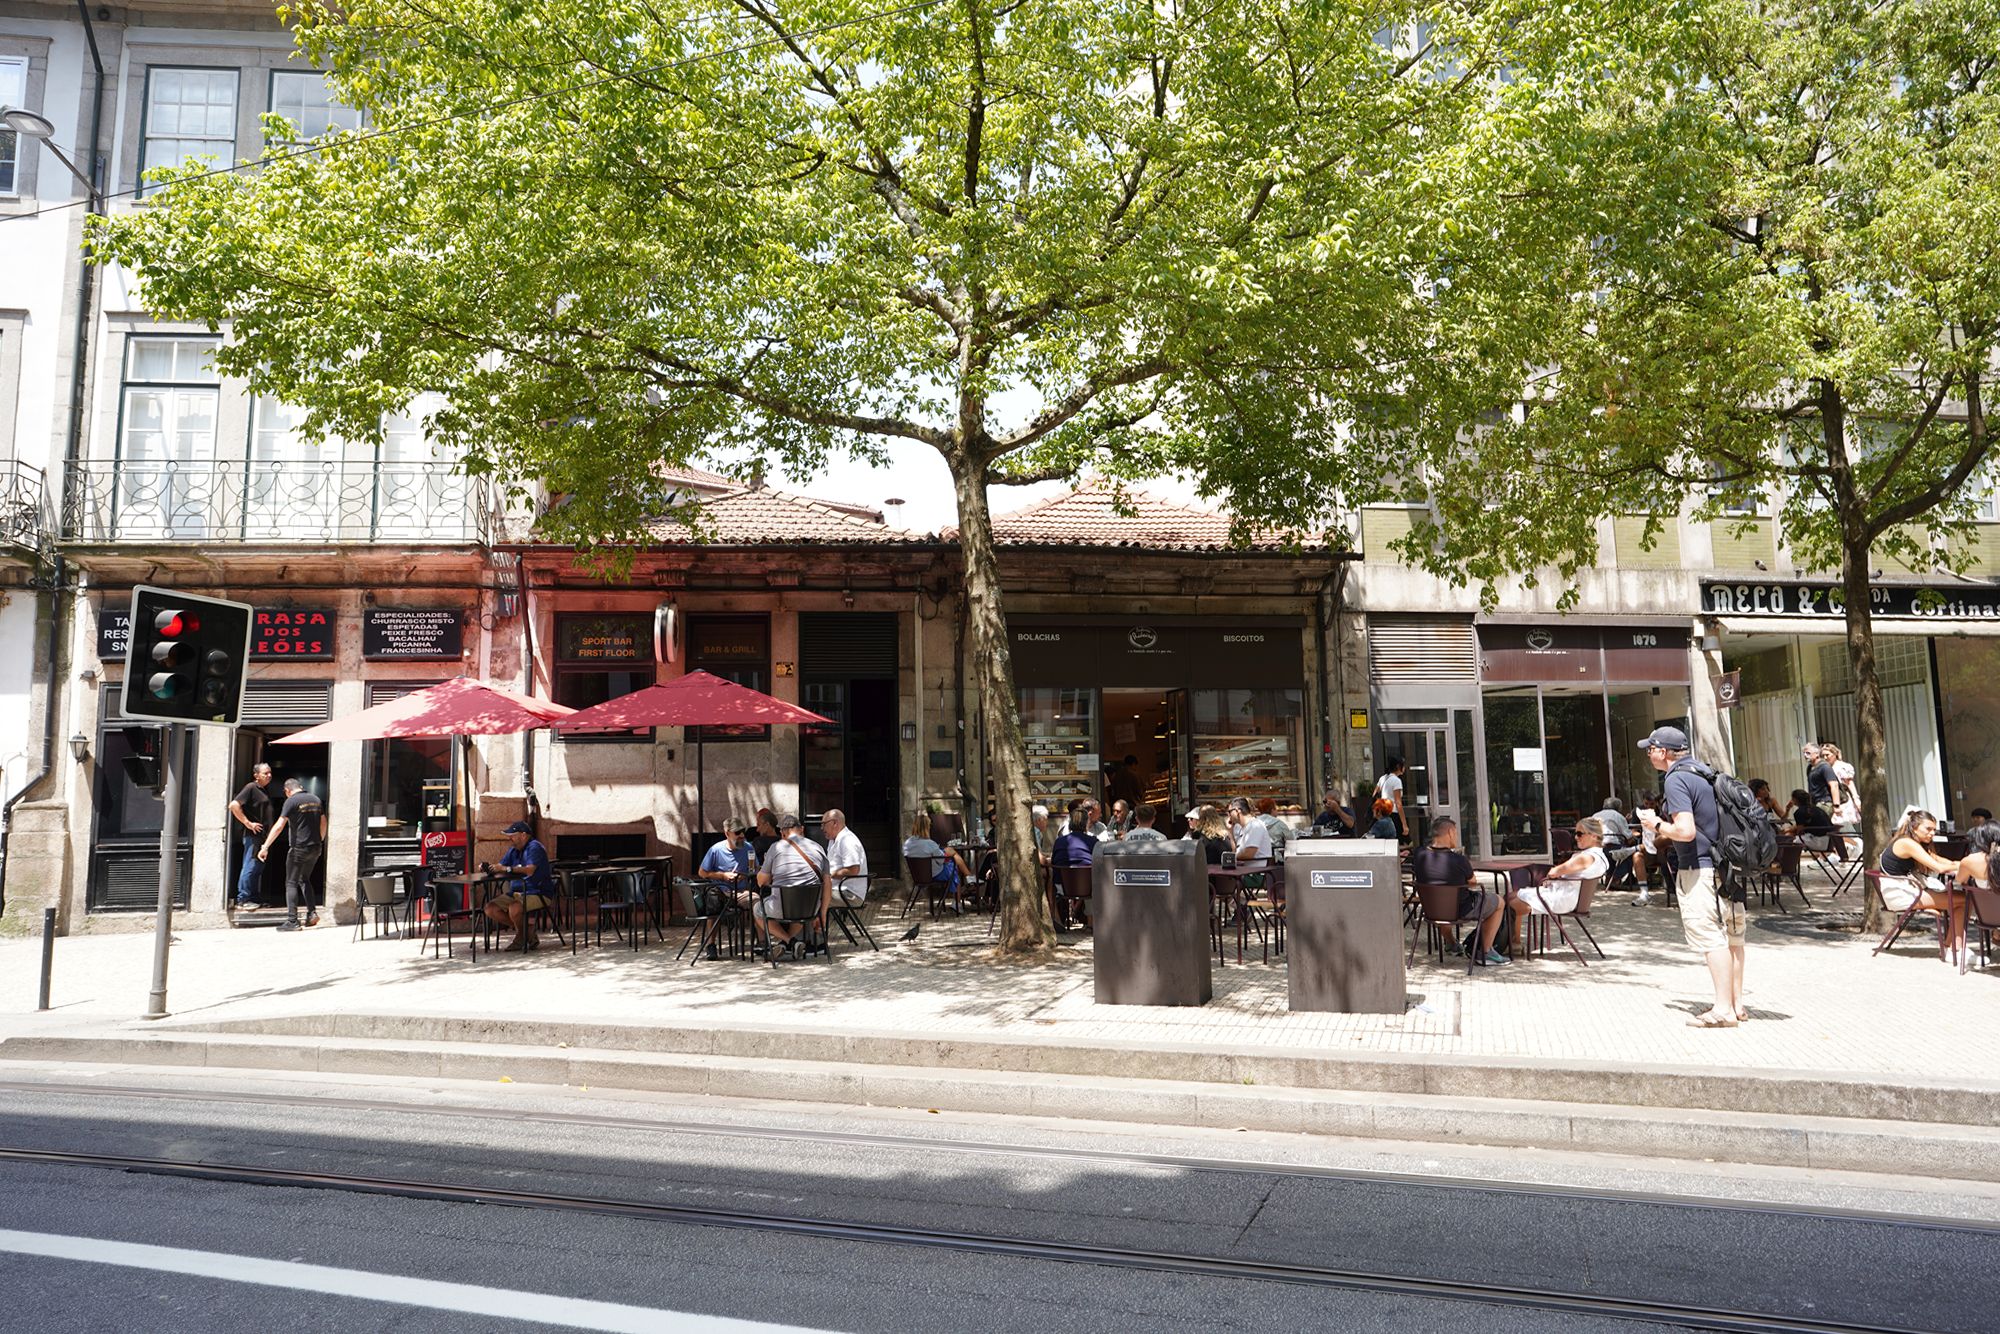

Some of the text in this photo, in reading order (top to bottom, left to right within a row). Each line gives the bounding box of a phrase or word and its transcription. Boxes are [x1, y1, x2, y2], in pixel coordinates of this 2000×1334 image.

[1710, 585, 1784, 613] MELO
[1798, 586, 1816, 613] &
[114, 617, 131, 627] TA
[257, 612, 326, 625] RASA
[103, 629, 129, 639] RES
[263, 627, 301, 636] DOS
[581, 637, 633, 645] SPORT BAR
[1017, 633, 1061, 641] BOLACHAS
[1223, 634, 1265, 642] BISCOITOS
[1632, 634, 1657, 646] 1878
[111, 641, 129, 651] SN
[249, 638, 322, 653] EÕES
[703, 645, 722, 654] BAR
[578, 649, 636, 657] FIRST FLOOR
